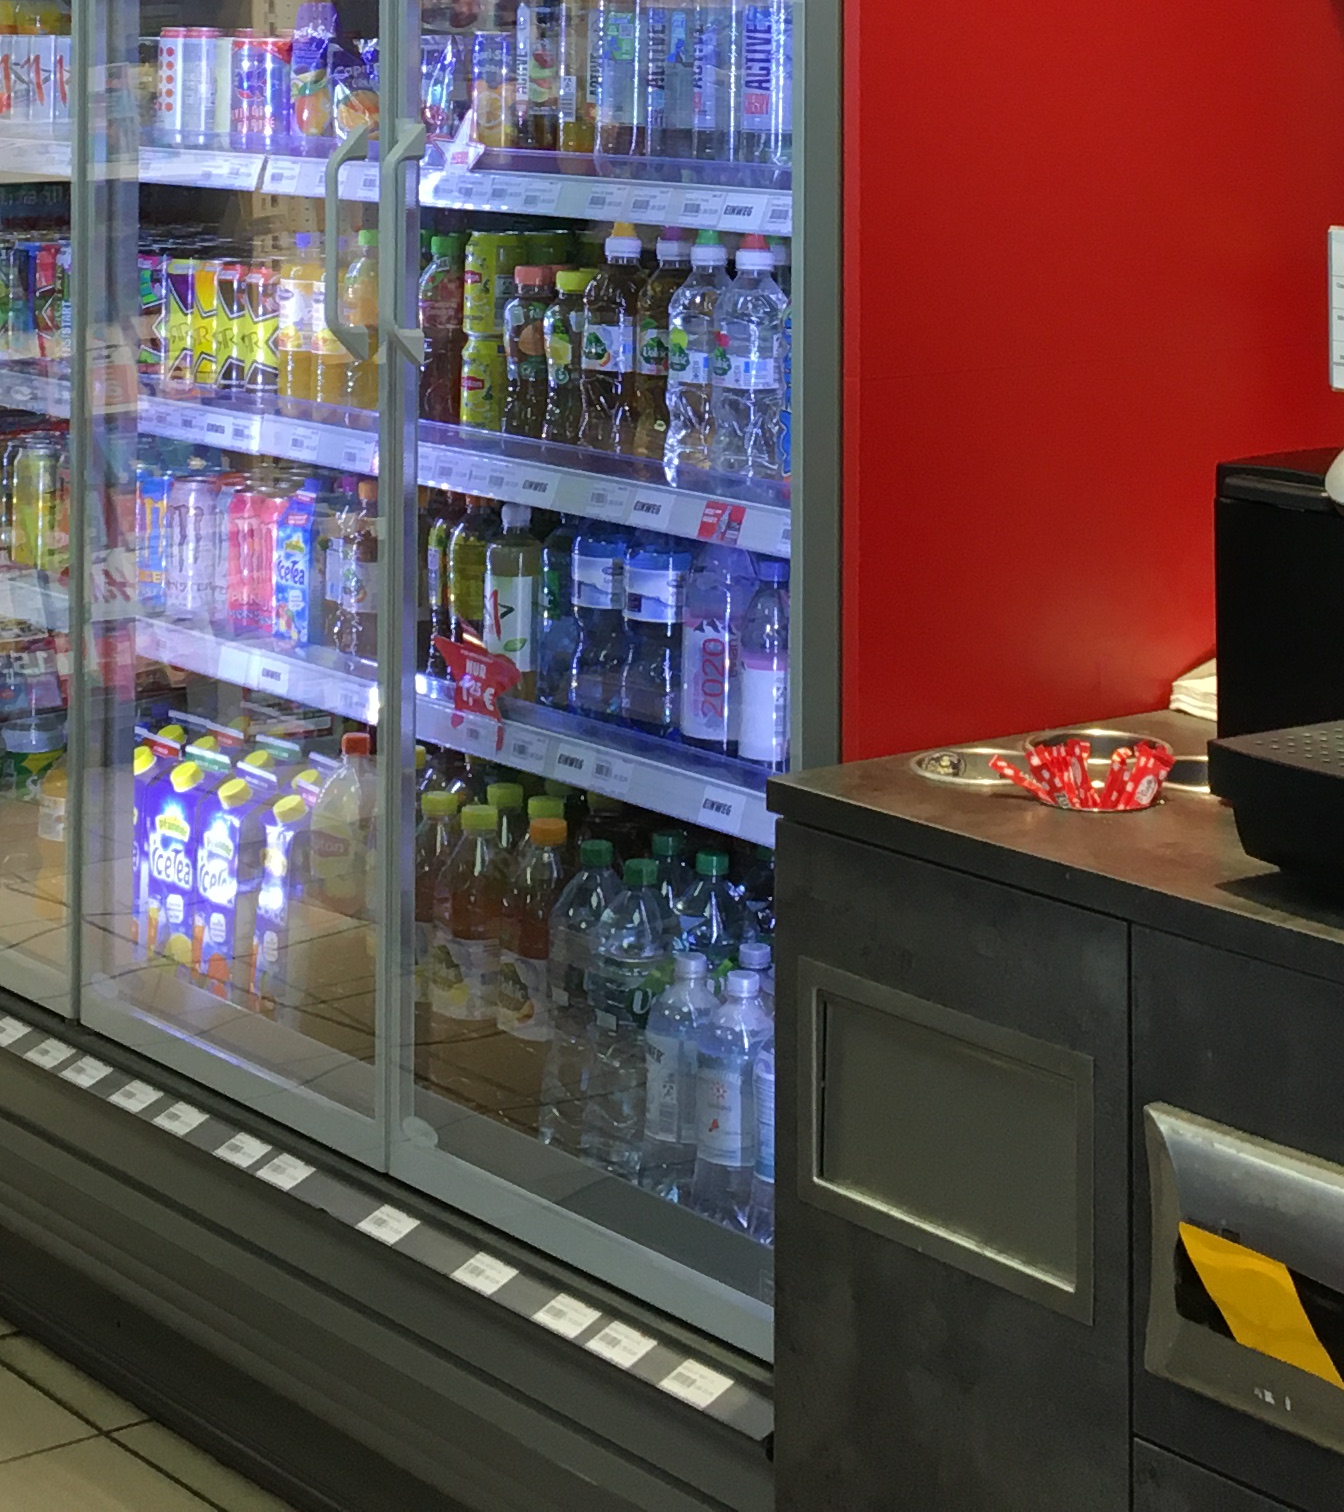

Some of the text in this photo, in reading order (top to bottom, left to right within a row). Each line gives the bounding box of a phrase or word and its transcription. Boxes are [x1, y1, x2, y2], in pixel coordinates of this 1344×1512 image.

[744, 23, 772, 92] ACTIVE
[723, 204, 754, 217] EINWEG
[633, 500, 663, 516] EINWEG
[465, 660, 487, 680] NUR
[701, 637, 726, 719] 2020
[483, 687, 496, 711] €
[702, 797, 732, 817] EINWEG
